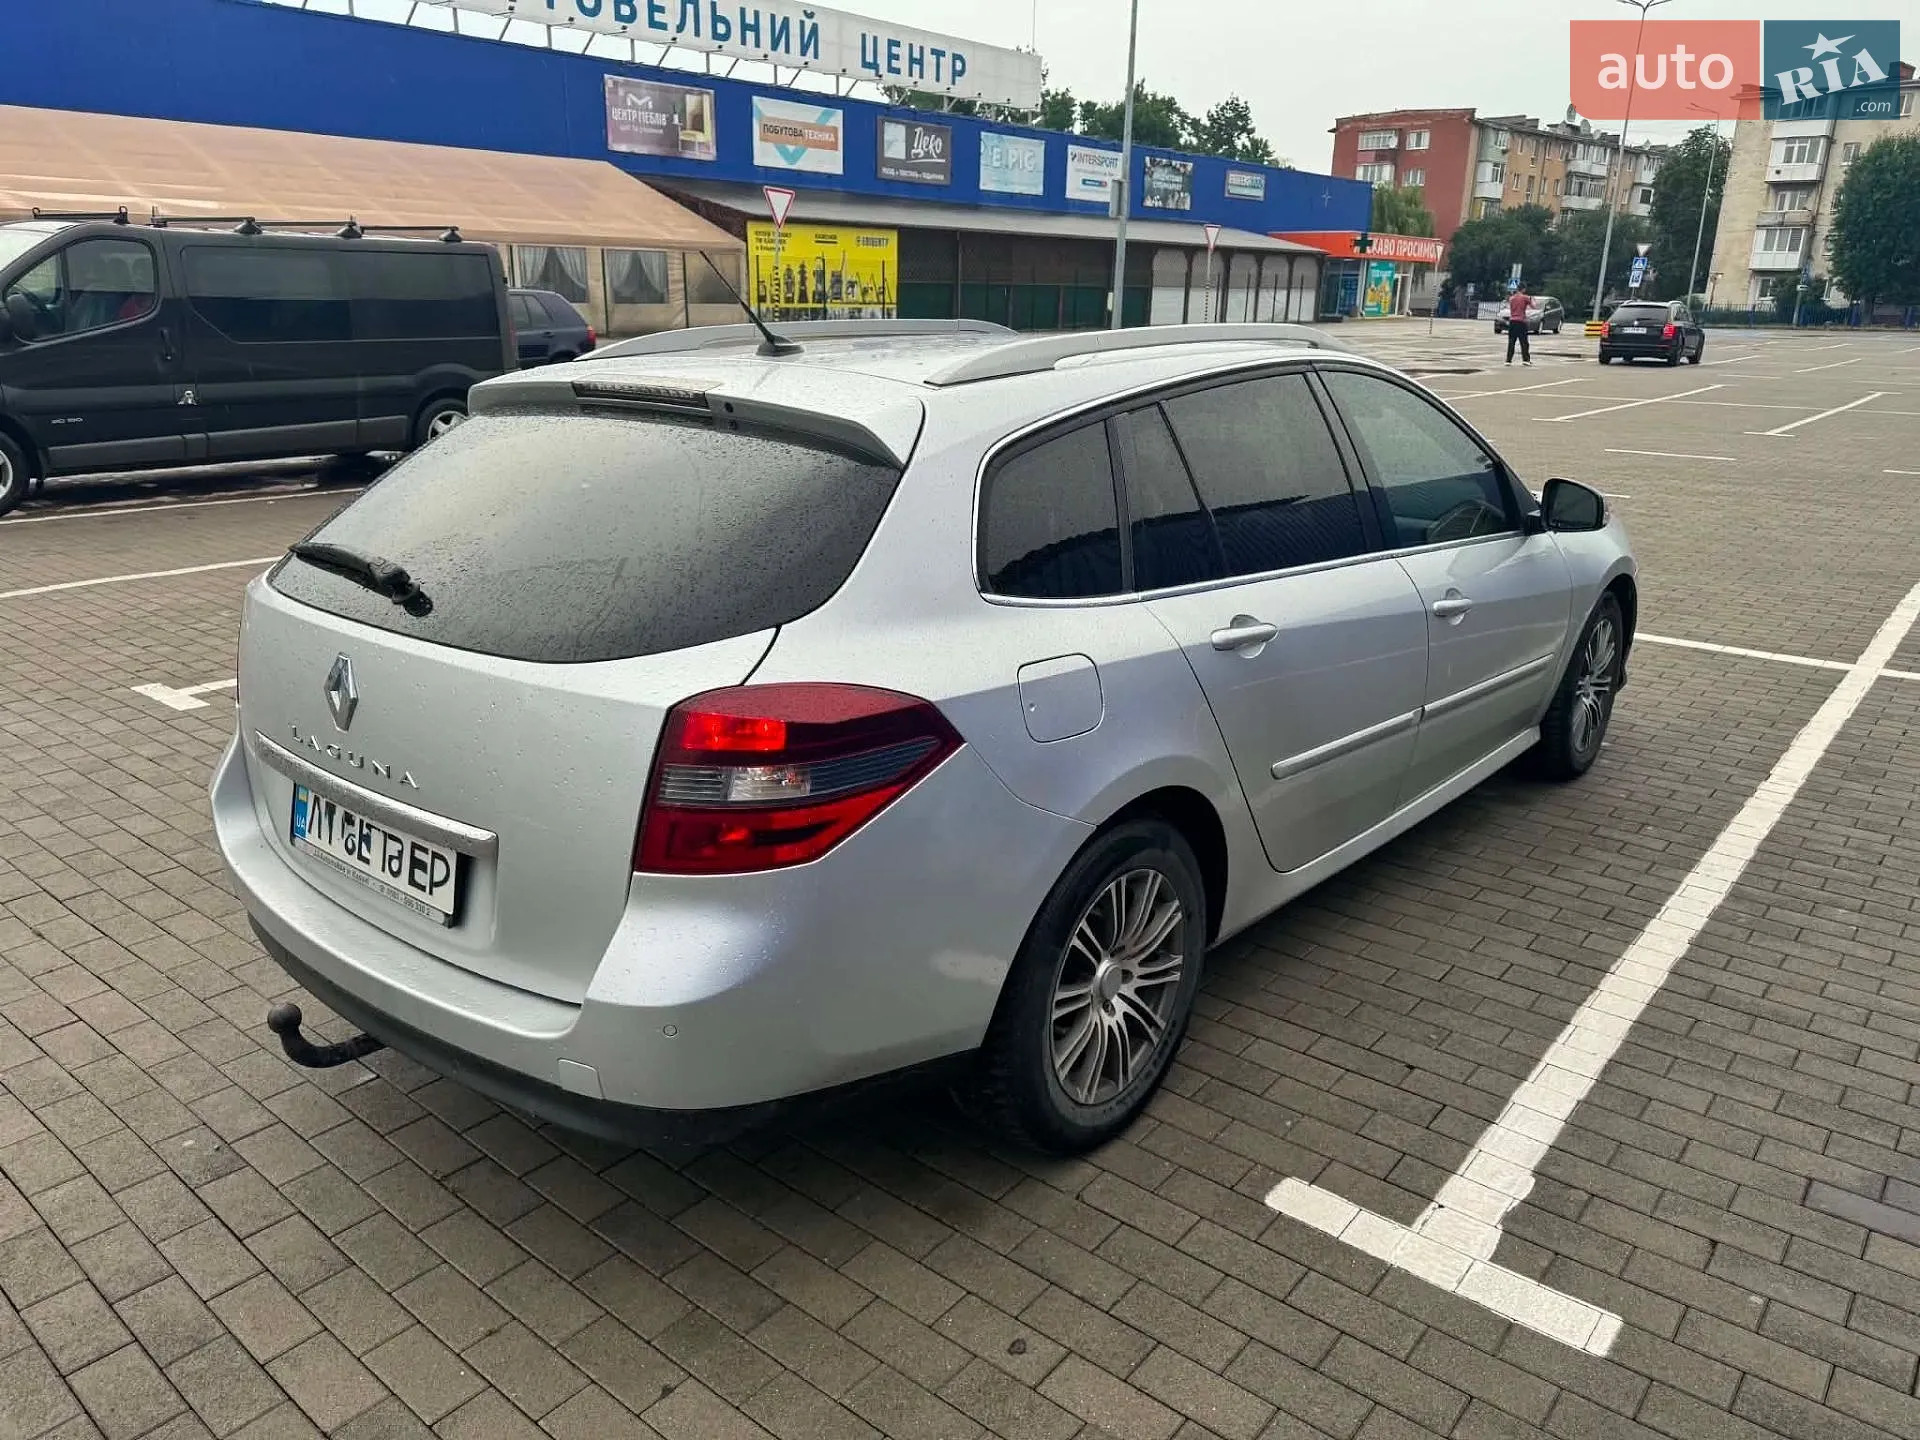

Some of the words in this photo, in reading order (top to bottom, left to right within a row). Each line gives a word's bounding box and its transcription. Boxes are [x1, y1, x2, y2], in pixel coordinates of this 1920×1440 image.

[546, 0, 819, 60] ОВЕЛЬНИЙ
[861, 32, 967, 86] ЦЕНТР
[291, 725, 420, 789] LAGUNA
